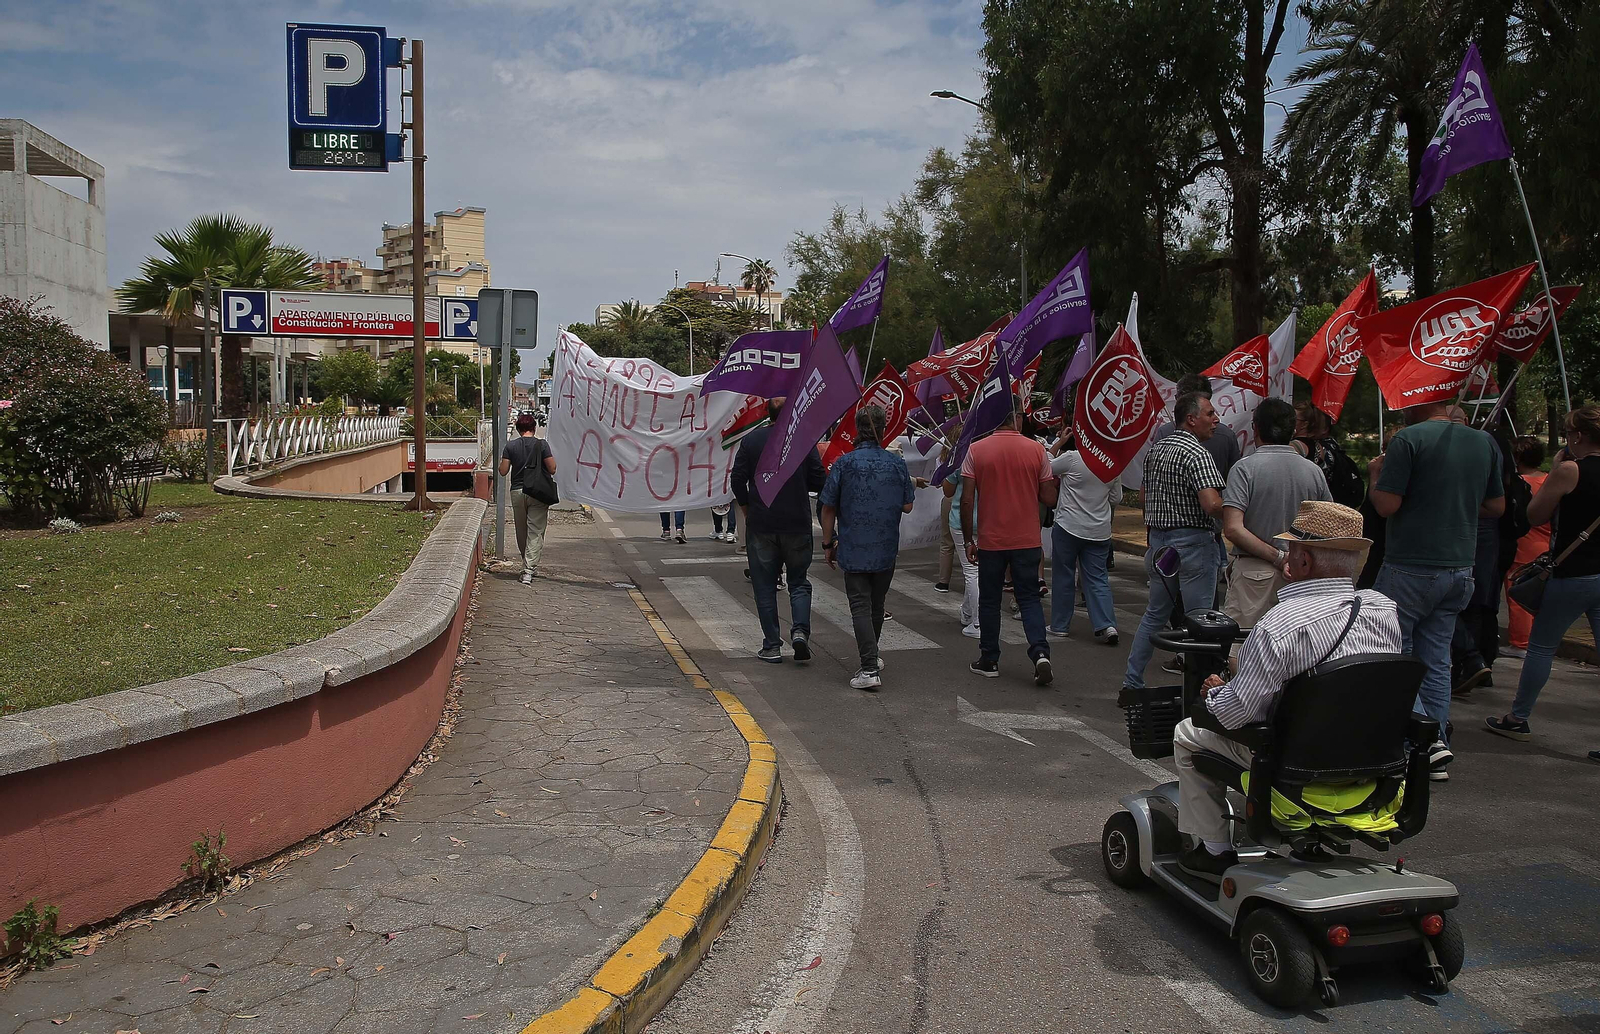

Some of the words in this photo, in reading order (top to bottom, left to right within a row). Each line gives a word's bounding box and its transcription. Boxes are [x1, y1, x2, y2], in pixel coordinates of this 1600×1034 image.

[308, 38, 366, 116] P
[313, 133, 359, 149] LIBRE
[228, 296, 252, 328] P
[278, 318, 344, 329] Constitución
[353, 321, 394, 330] Frontera
[279, 309, 364, 321] APARCAMIENTO
[367, 311, 412, 322] PÚBLICO
[447, 302, 470, 336] P
[1421, 305, 1485, 347] UGT
